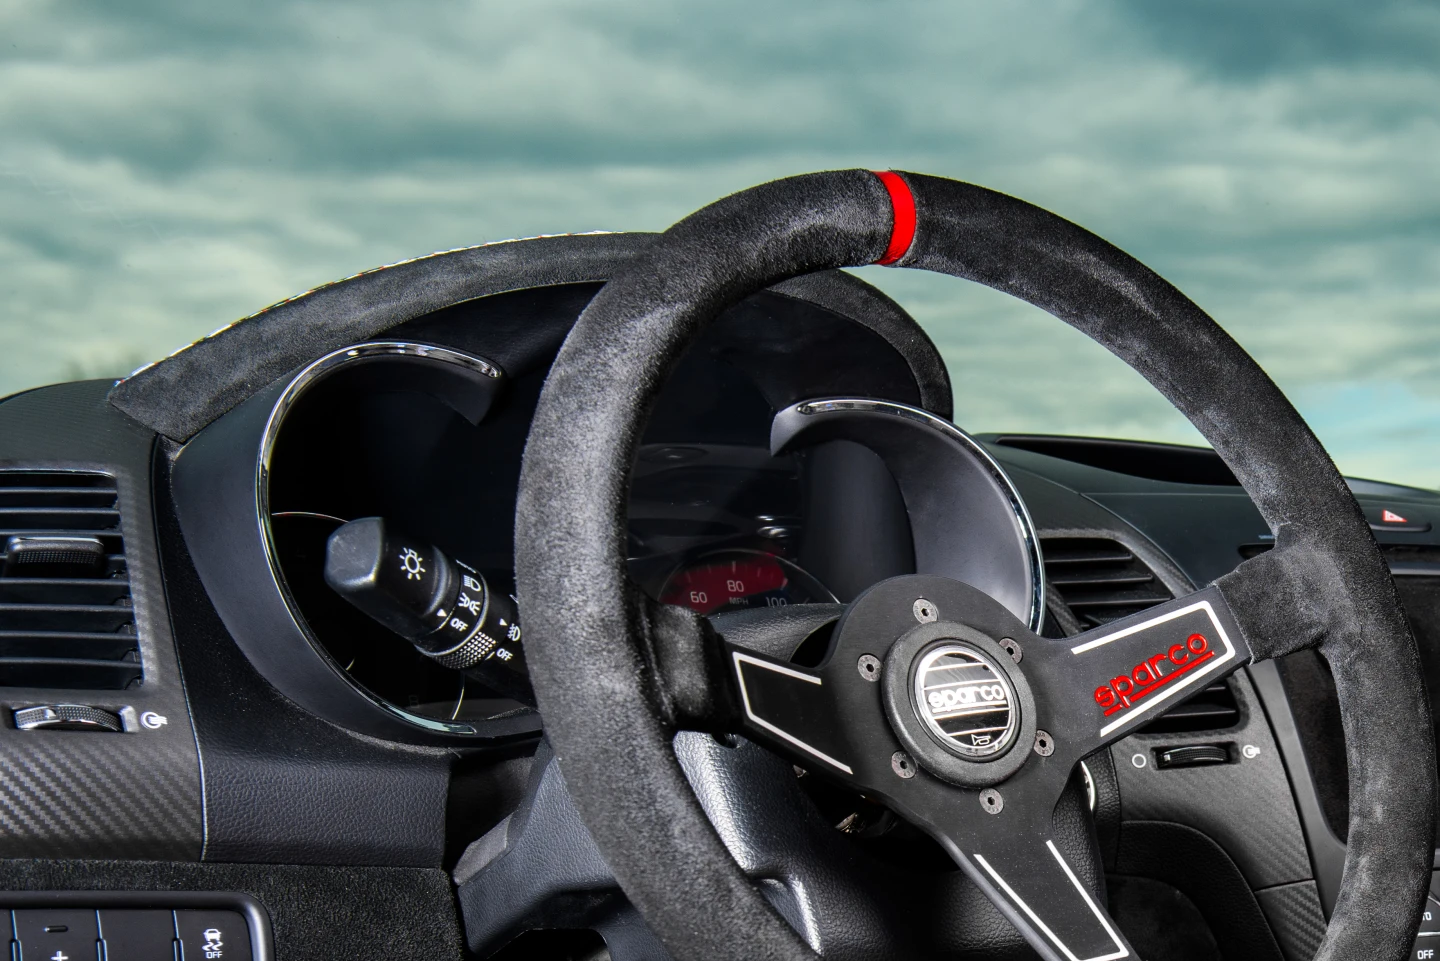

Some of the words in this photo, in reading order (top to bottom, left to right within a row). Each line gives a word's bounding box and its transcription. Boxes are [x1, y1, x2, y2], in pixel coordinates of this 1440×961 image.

[726, 580, 744, 593] 80
[690, 591, 708, 604] 60
[729, 597, 749, 606] MPH
[450, 618, 468, 632] OFF
[496, 648, 513, 661] OFF
[1094, 633, 1210, 711] sparco
[928, 684, 1005, 712] sparco
[206, 951, 223, 959] OFF
[1417, 949, 1434, 960] OFF
